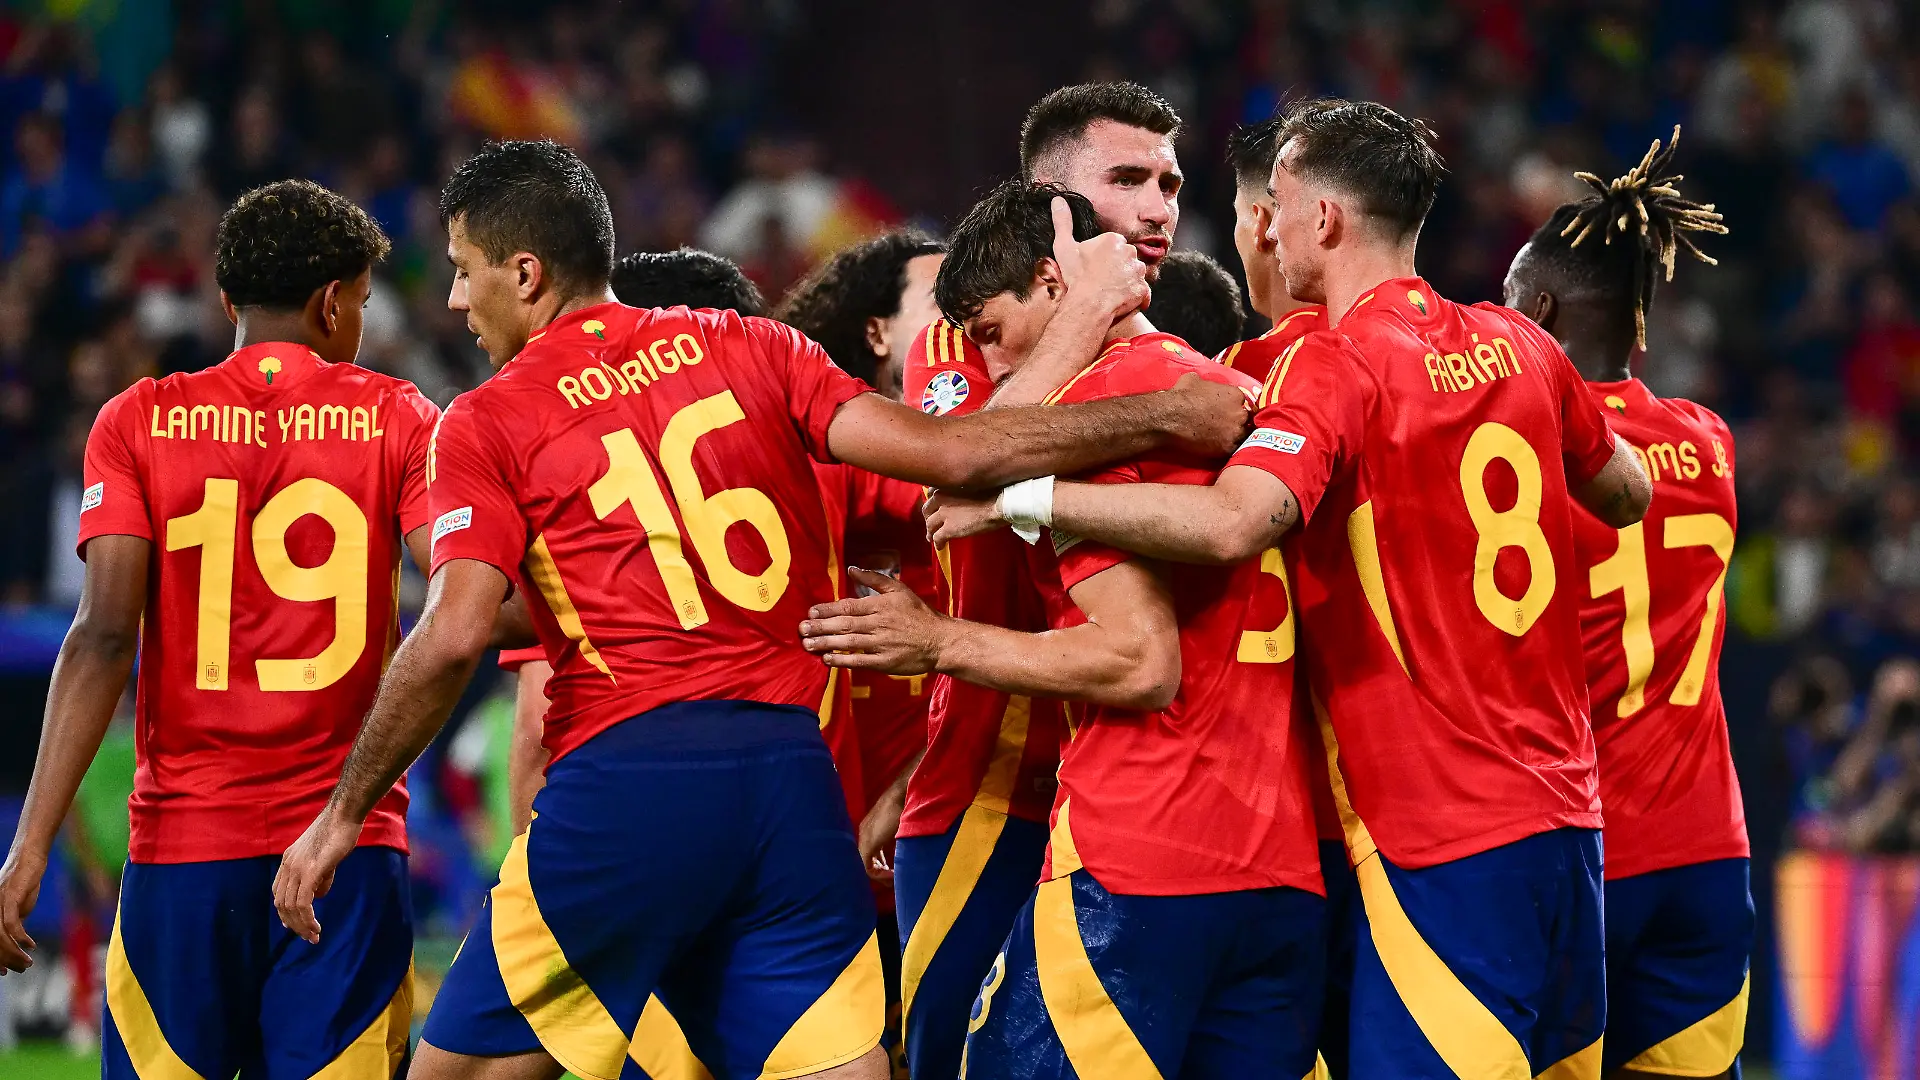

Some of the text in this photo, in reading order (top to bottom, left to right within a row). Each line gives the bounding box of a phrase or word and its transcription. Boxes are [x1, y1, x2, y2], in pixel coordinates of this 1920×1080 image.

[557, 333, 704, 409] RODRIGO
[1424, 333, 1523, 394] FABIÁN
[151, 404, 384, 448] LAMINE YAMAL
[1249, 434, 1300, 448] NDATION
[438, 513, 469, 529] ATION
[587, 389, 792, 631] 16
[1460, 422, 1556, 637] 8
[166, 477, 369, 692] 19
[1589, 513, 1737, 719] 17
